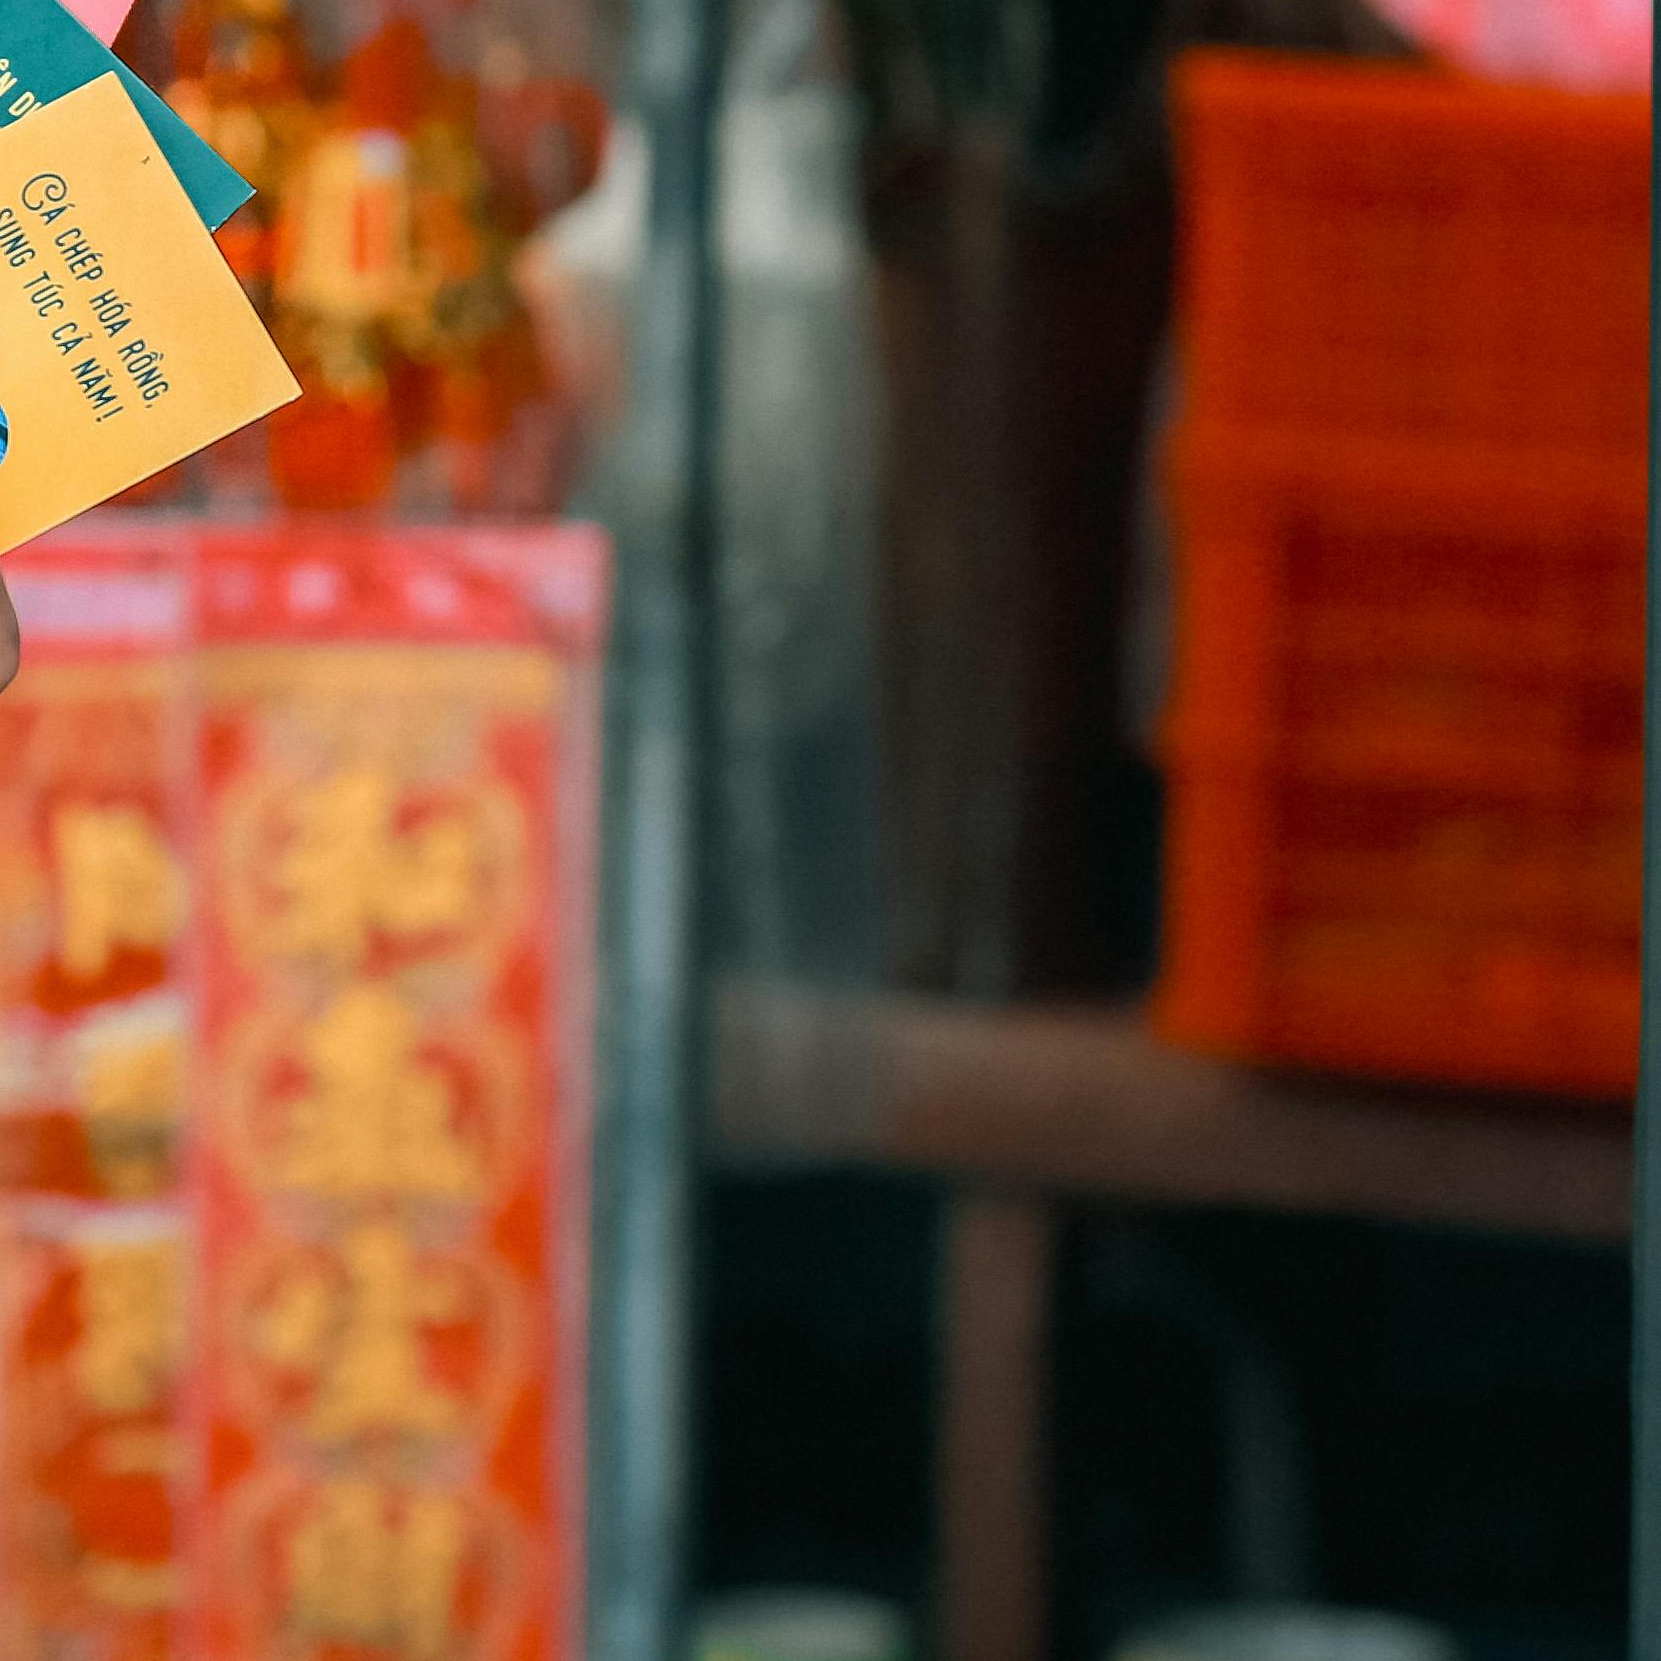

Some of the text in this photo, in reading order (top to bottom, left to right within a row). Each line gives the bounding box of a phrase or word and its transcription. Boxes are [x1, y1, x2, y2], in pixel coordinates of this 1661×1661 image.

[22, 173, 169, 409] CÁ CHÉP HÓA RỒNG,
[23, 271, 65, 318] TÚC
[51, 322, 93, 357] CẢ
